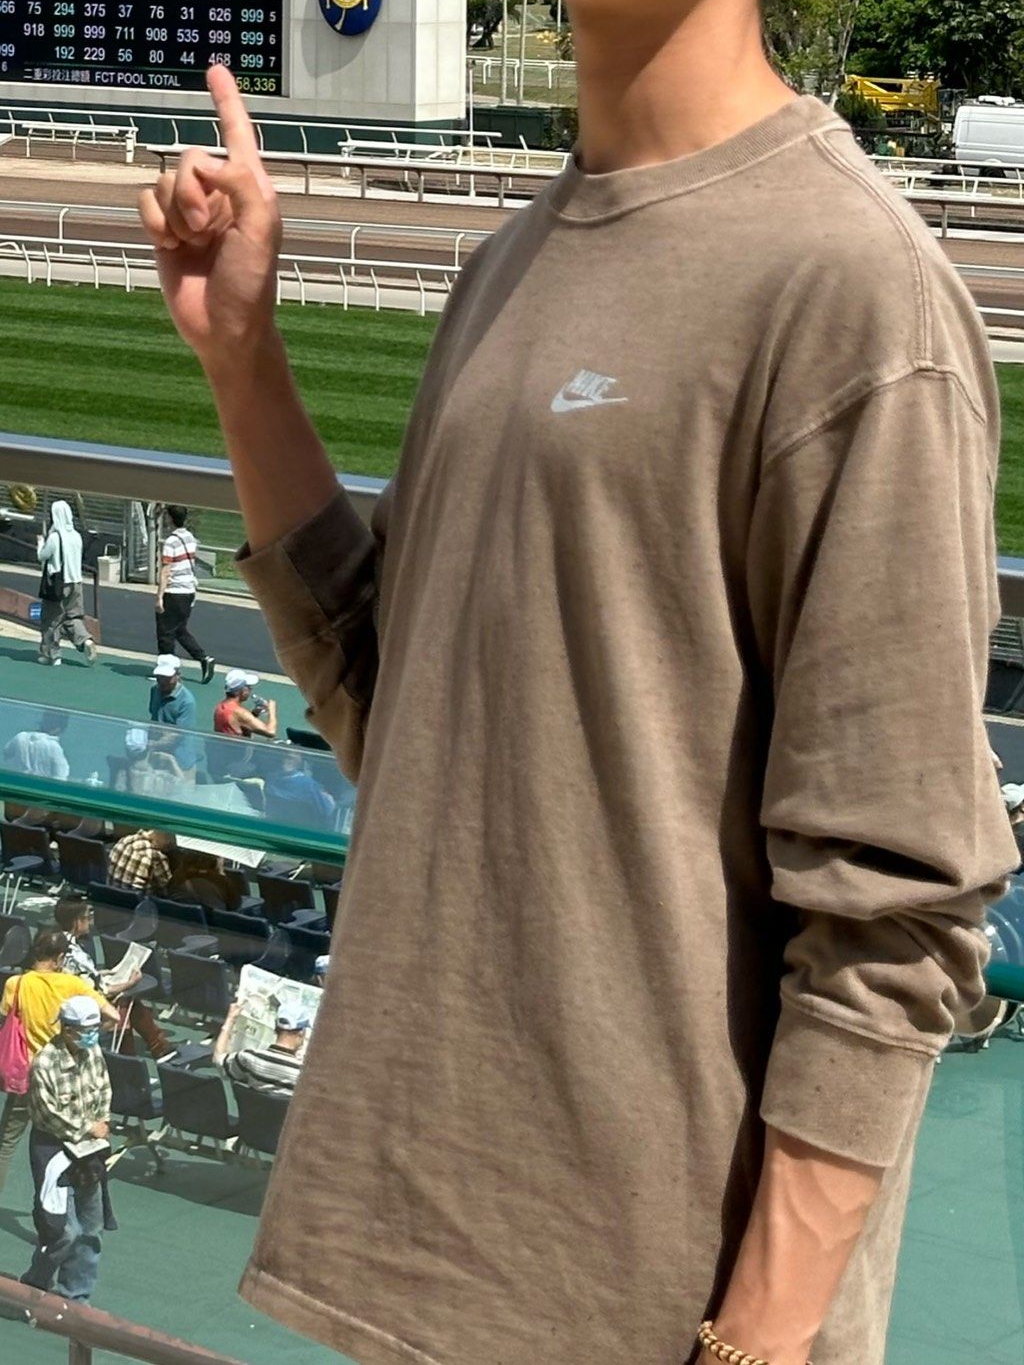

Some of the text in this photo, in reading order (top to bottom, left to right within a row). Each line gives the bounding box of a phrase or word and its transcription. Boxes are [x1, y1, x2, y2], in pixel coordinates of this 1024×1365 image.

[95, 72, 115, 83] FCT
[117, 73, 146, 85] POOL
[148, 74, 181, 86] TOTAL
[566, 369, 616, 399] NIKE
